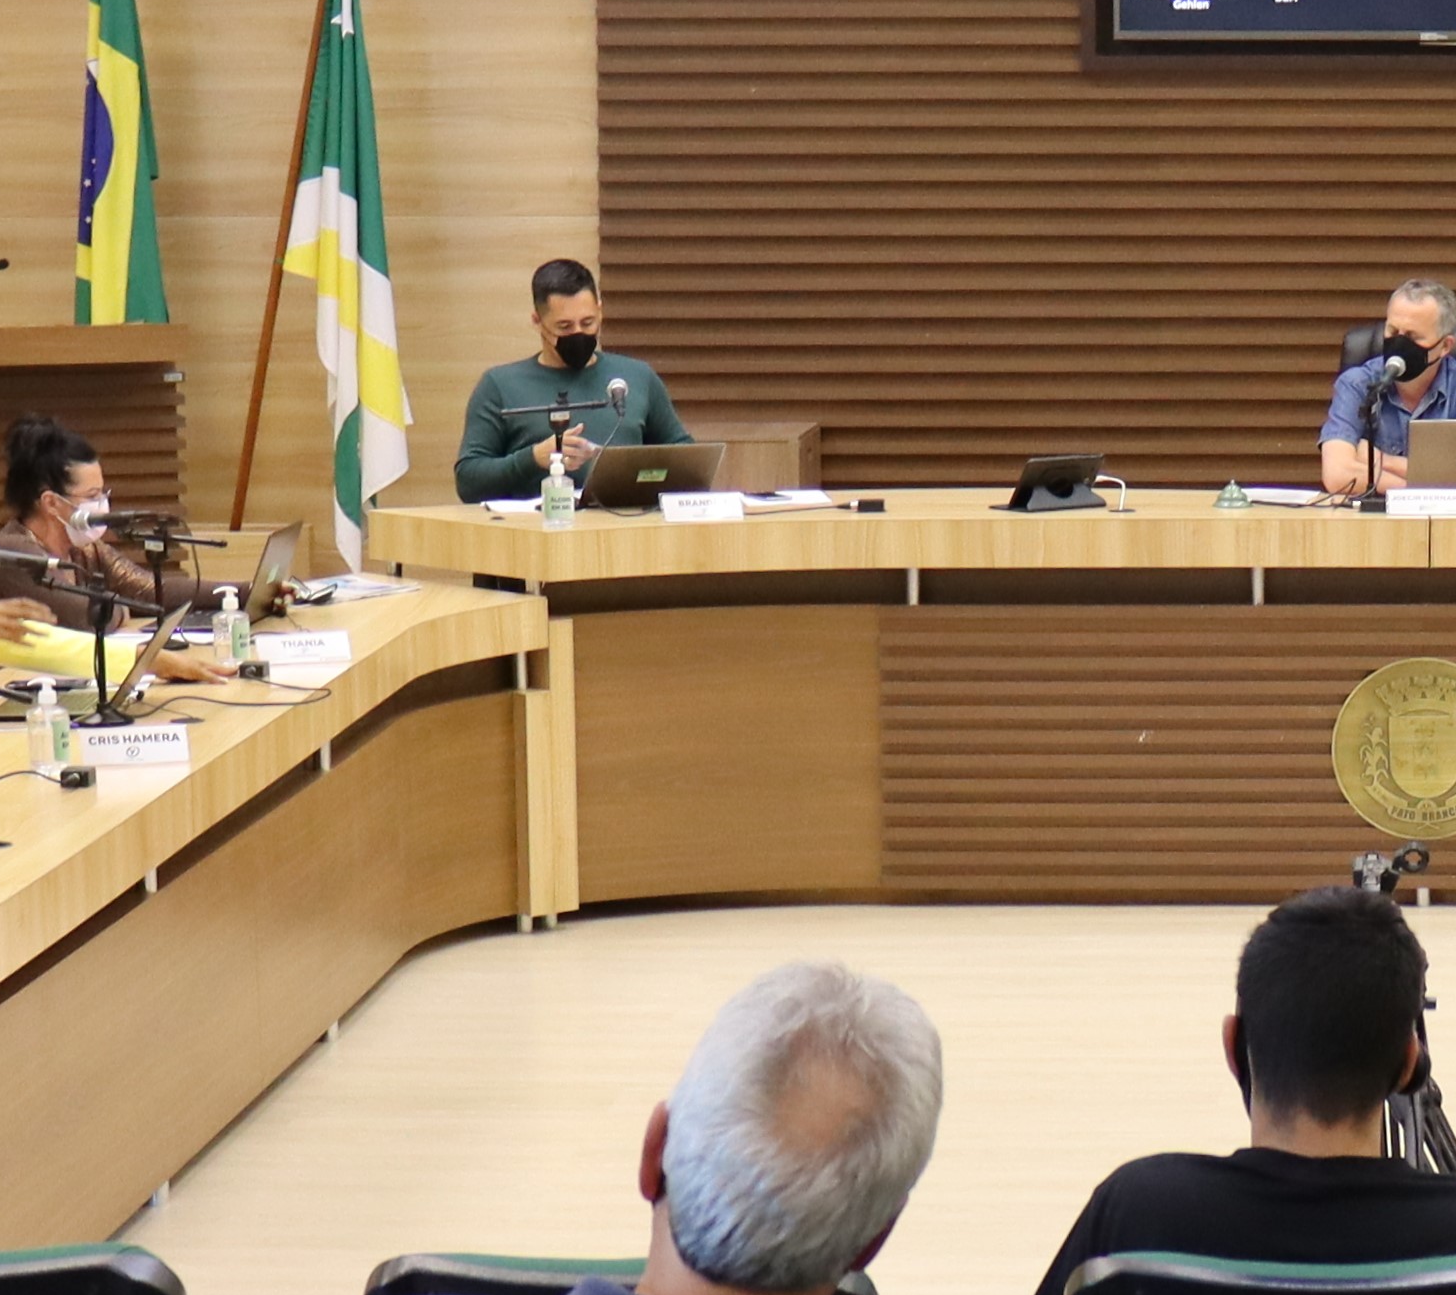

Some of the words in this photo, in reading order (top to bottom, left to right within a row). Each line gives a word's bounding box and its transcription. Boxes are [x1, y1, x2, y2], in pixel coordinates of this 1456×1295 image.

[282, 639, 326, 649] THANIA
[88, 735, 120, 746] CRIS
[123, 732, 180, 745] HAMERA
[1390, 806, 1416, 820] PATO
